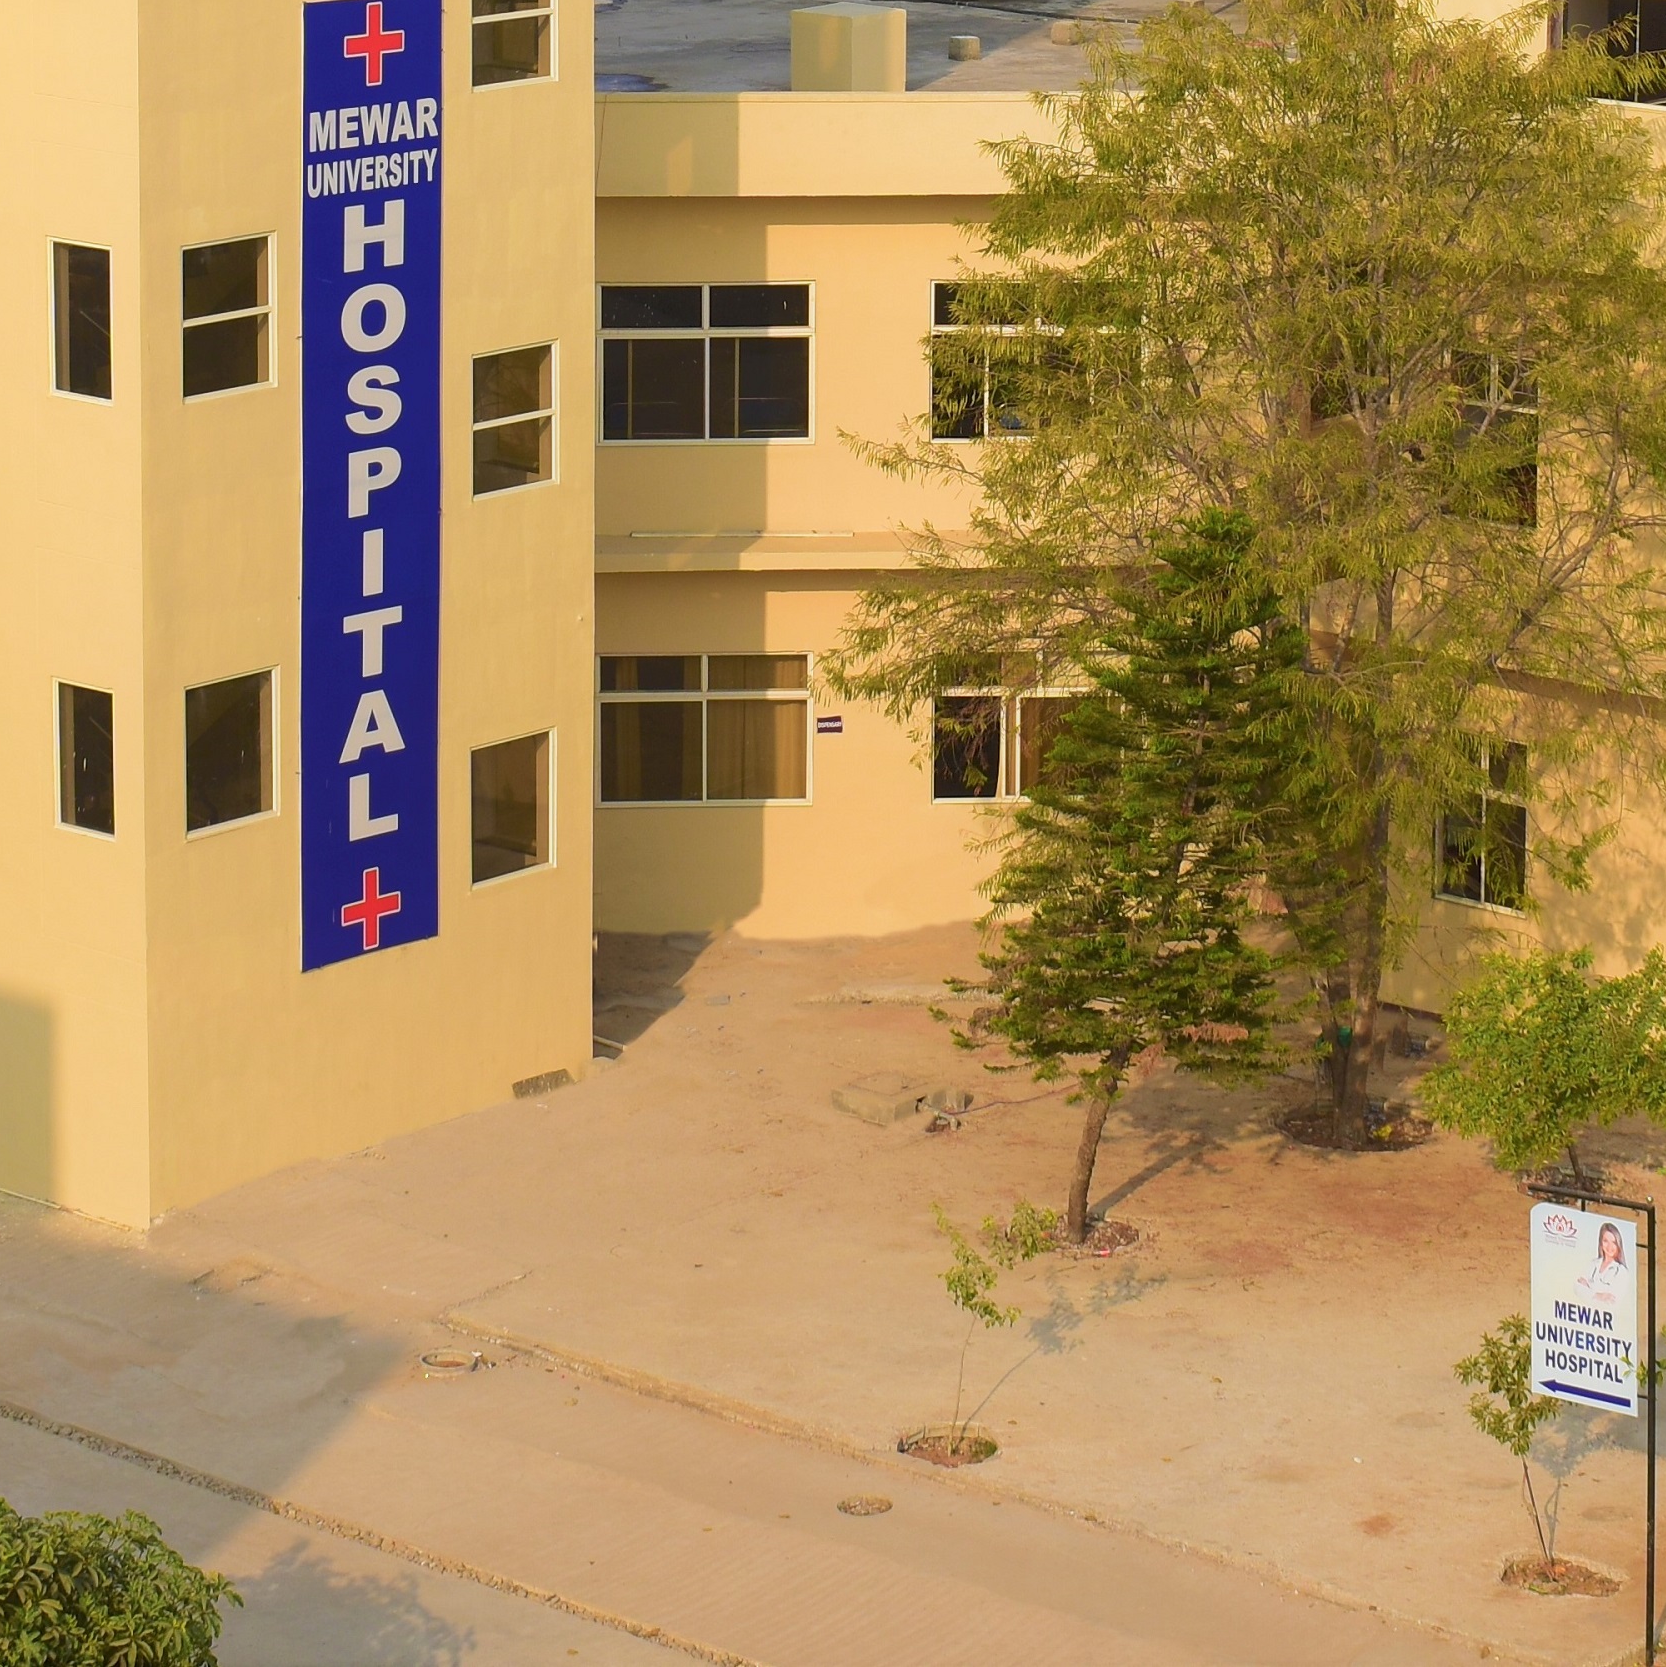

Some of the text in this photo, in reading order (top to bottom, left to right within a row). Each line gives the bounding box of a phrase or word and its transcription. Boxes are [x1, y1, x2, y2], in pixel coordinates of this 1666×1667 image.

[309, 97, 439, 153] MEWAR
[307, 147, 438, 199] UNIVERSITY
[338, 198, 407, 842] HOSPITAL
[1554, 1299, 1613, 1331] MEWAR
[1535, 1320, 1632, 1359] UNIVERSITY
[1545, 1348, 1623, 1384] HOSPITAL
